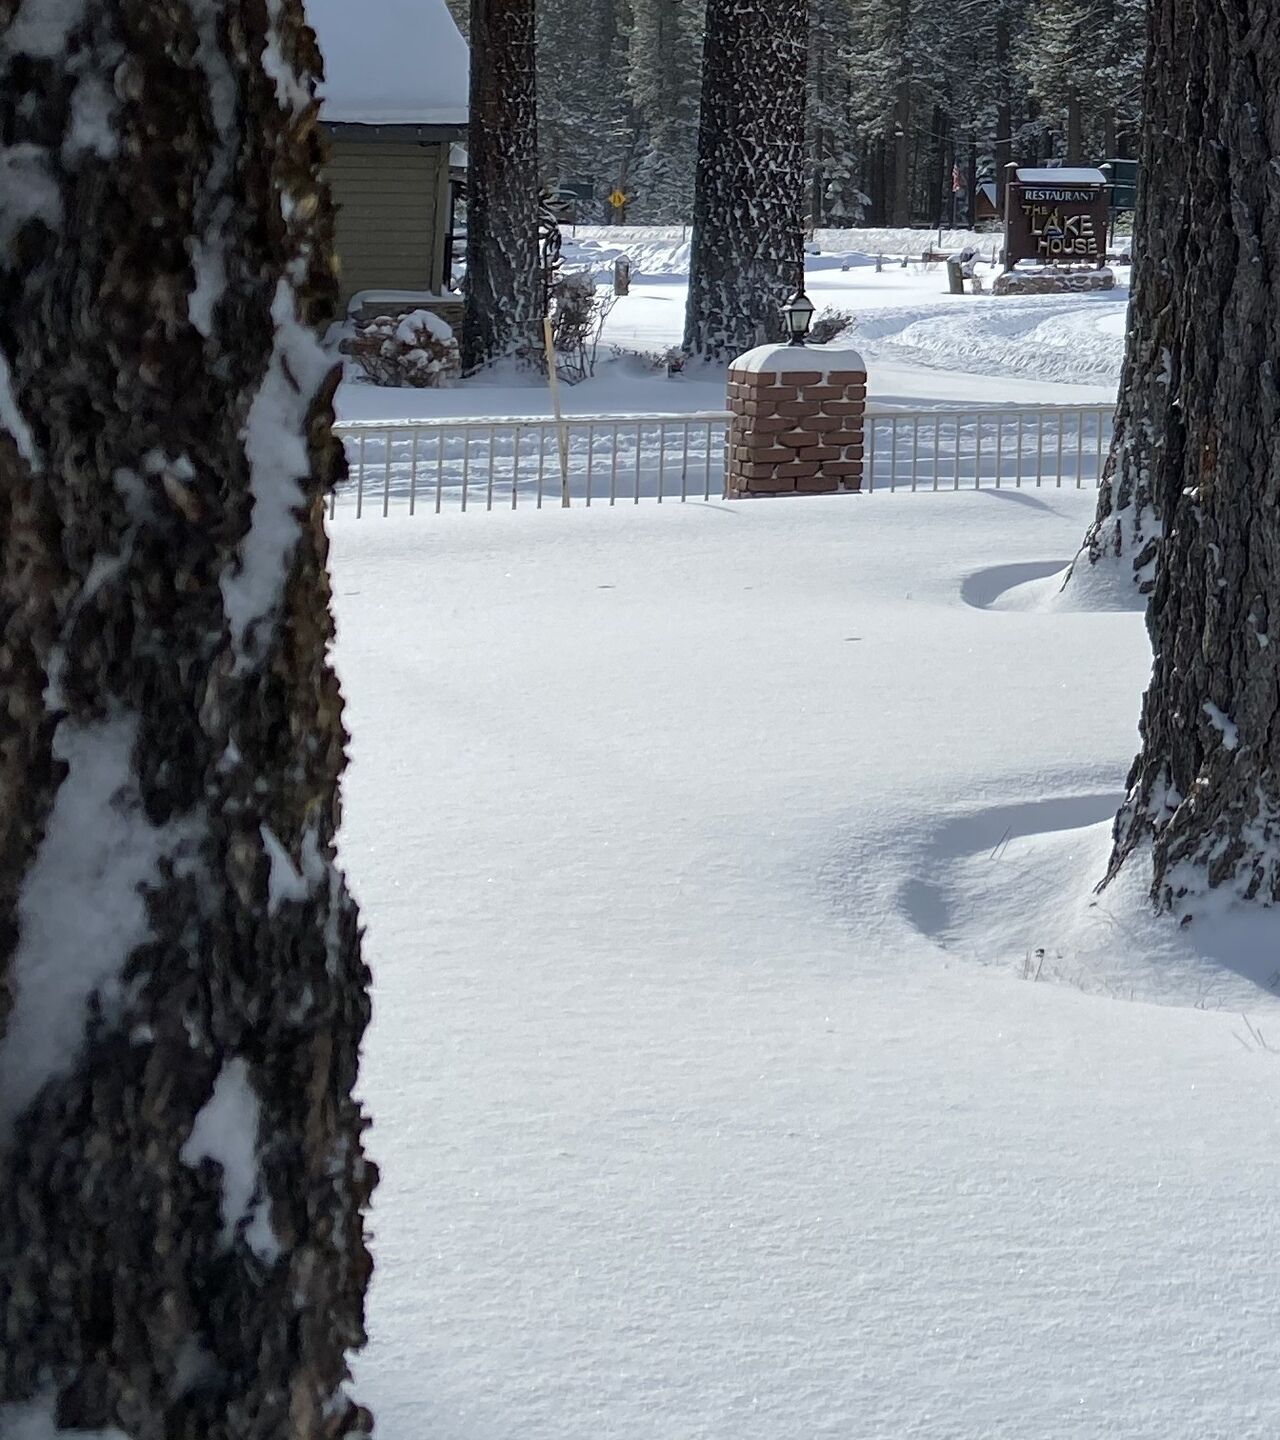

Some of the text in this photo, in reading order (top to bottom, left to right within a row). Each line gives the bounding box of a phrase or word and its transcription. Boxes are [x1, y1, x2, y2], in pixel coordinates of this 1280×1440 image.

[1025, 189, 1095, 201] RESTAURANT
[1021, 203, 1048, 216] THE
[1030, 207, 1095, 236] LAKE
[1037, 236, 1098, 256] HOUSE
